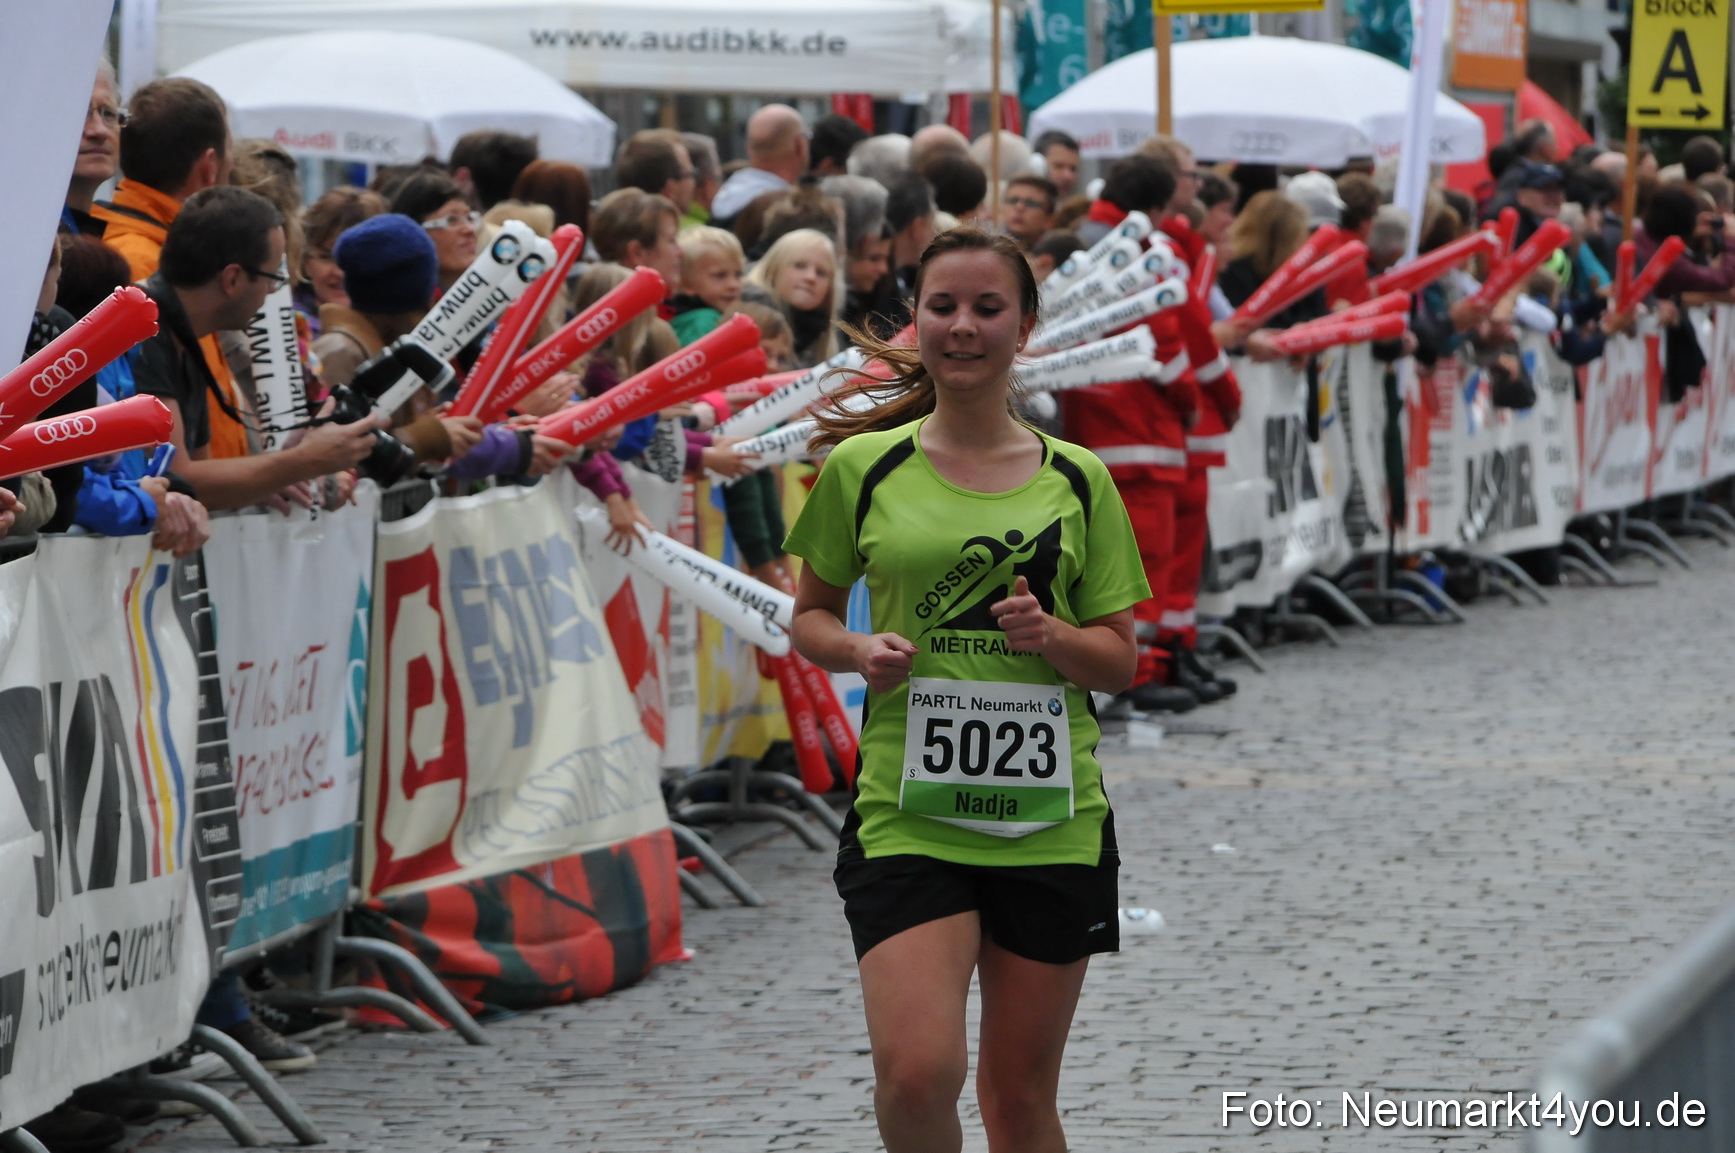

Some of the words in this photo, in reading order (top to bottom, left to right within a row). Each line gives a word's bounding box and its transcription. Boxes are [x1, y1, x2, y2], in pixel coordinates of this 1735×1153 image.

[1645, 0, 1717, 16] Block
[529, 28, 848, 56] www.audibkk.de
[1651, 28, 1702, 95] A
[273, 127, 337, 149] Audi
[345, 132, 400, 154] BKK
[490, 373, 531, 409] Audi
[527, 345, 568, 378] BKK
[572, 403, 615, 436] Audi
[613, 380, 654, 410] BKK
[915, 551, 987, 620] GOSSEN
[912, 693, 966, 710] PARTL
[971, 697, 1043, 713] Neumarkt
[923, 718, 1057, 779] 5023
[955, 791, 1018, 820] Nadja
